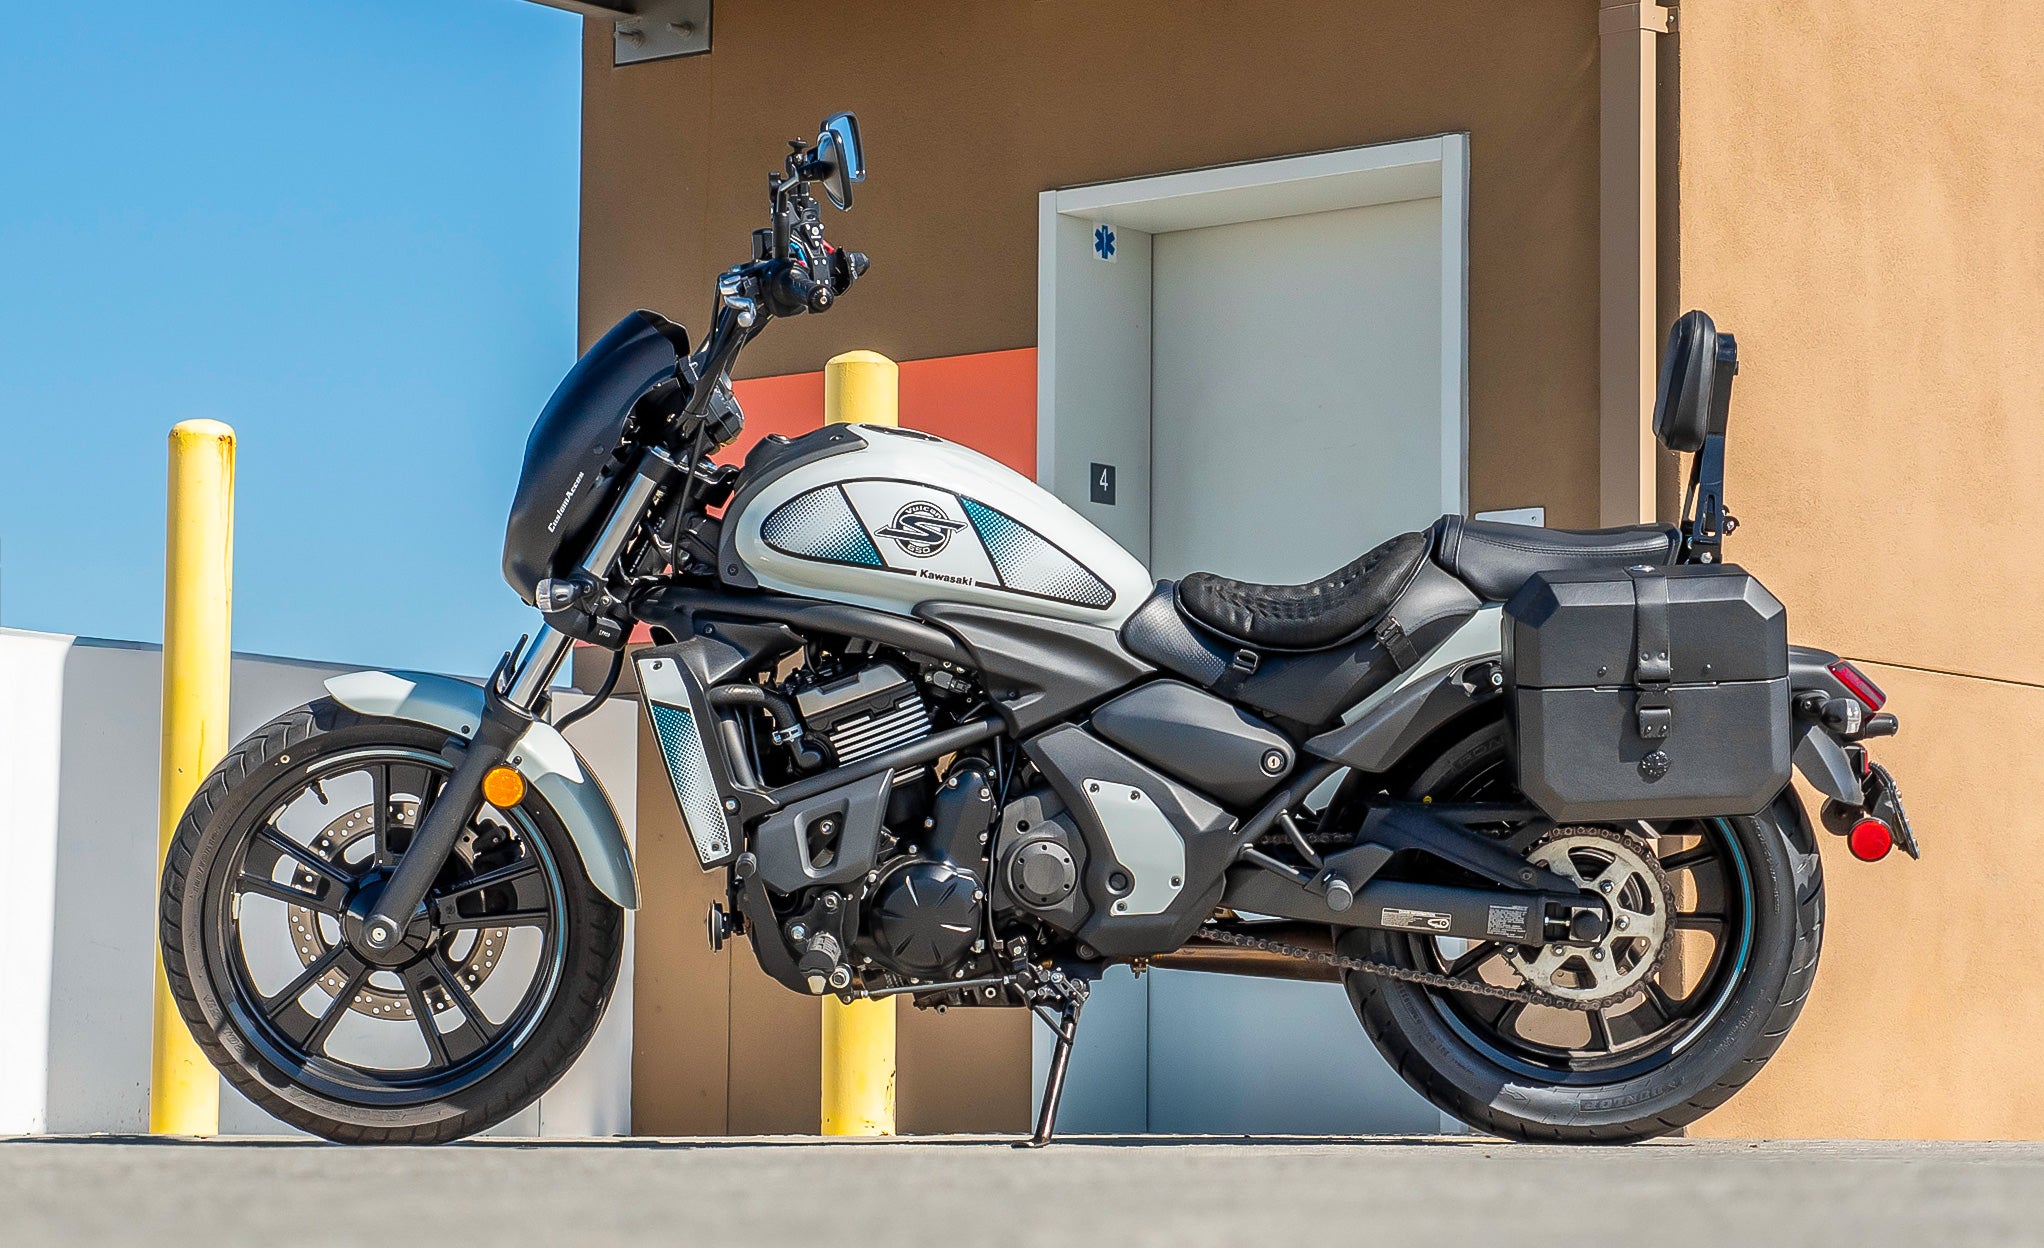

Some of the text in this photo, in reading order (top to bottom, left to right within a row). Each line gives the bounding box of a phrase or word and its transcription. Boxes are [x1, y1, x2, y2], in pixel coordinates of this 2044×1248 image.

[1099, 468, 1109, 491] 4
[907, 543, 931, 554] 650
[919, 569, 973, 586] Kawasaki
